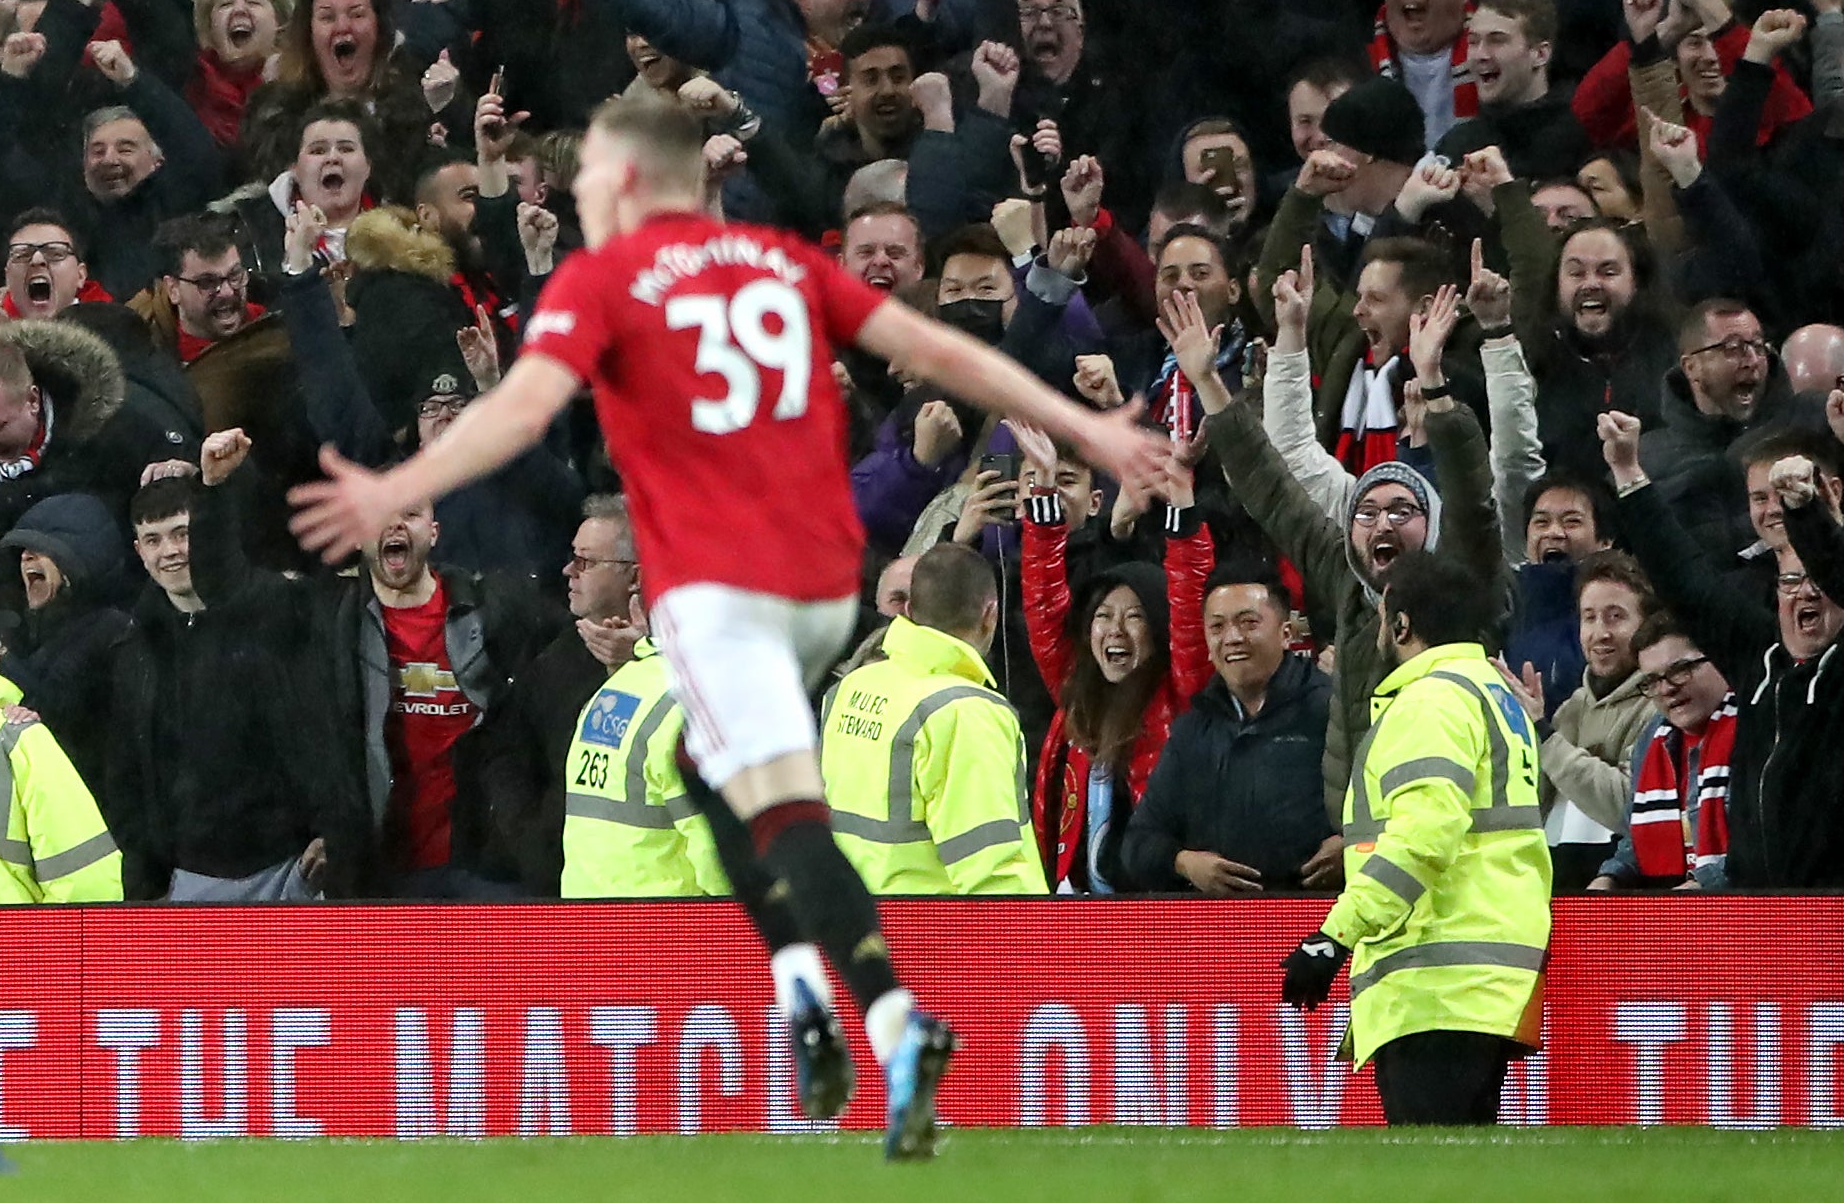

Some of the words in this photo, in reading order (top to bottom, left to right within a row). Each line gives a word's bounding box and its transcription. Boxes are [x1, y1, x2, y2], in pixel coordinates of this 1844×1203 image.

[664, 277, 812, 434] 39
[602, 713, 630, 738] CSG
[576, 750, 609, 790] 263
